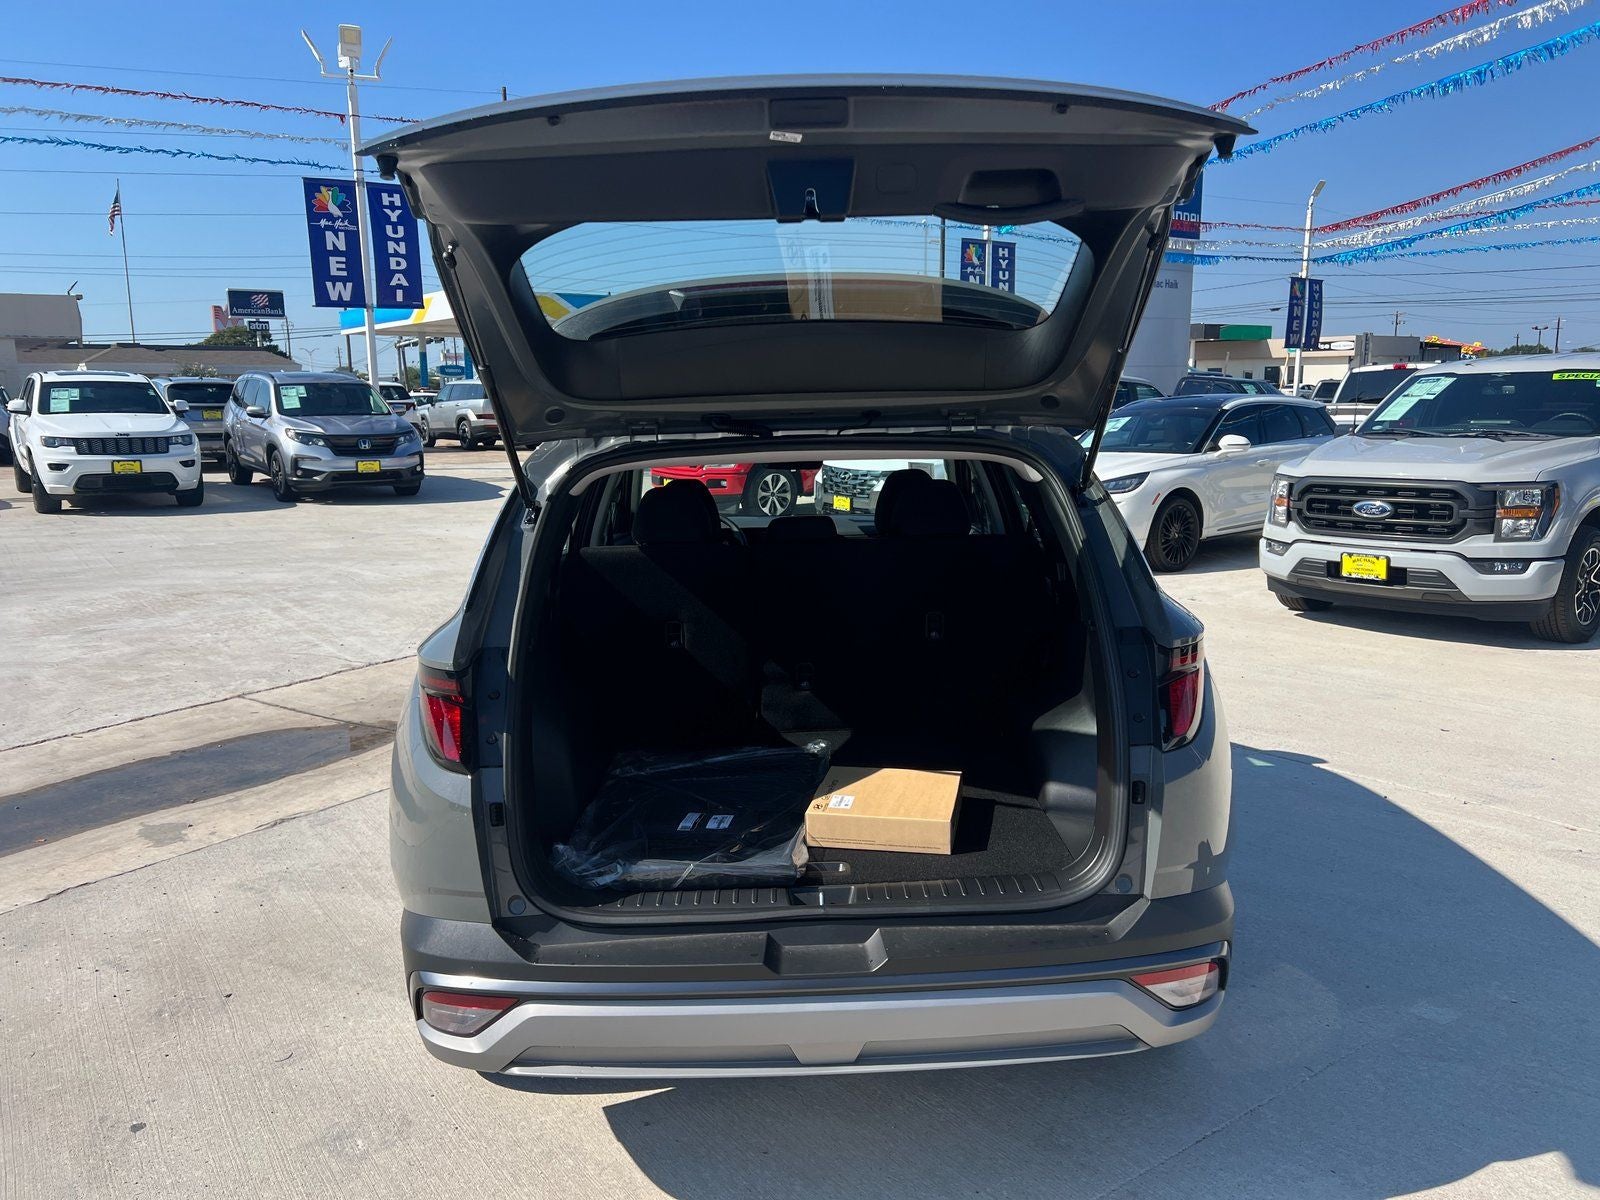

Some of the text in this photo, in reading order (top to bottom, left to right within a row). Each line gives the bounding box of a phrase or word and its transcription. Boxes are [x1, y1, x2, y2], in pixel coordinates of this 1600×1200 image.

[325, 231, 353, 301] NEW
[381, 192, 409, 302] HYUNDAI
[998, 247, 1009, 292] HYUN
[1165, 279, 1179, 289] Haik
[249, 322, 269, 330] atm
[1289, 306, 1301, 345] NEW
[1311, 284, 1320, 345] HYUNDAI
